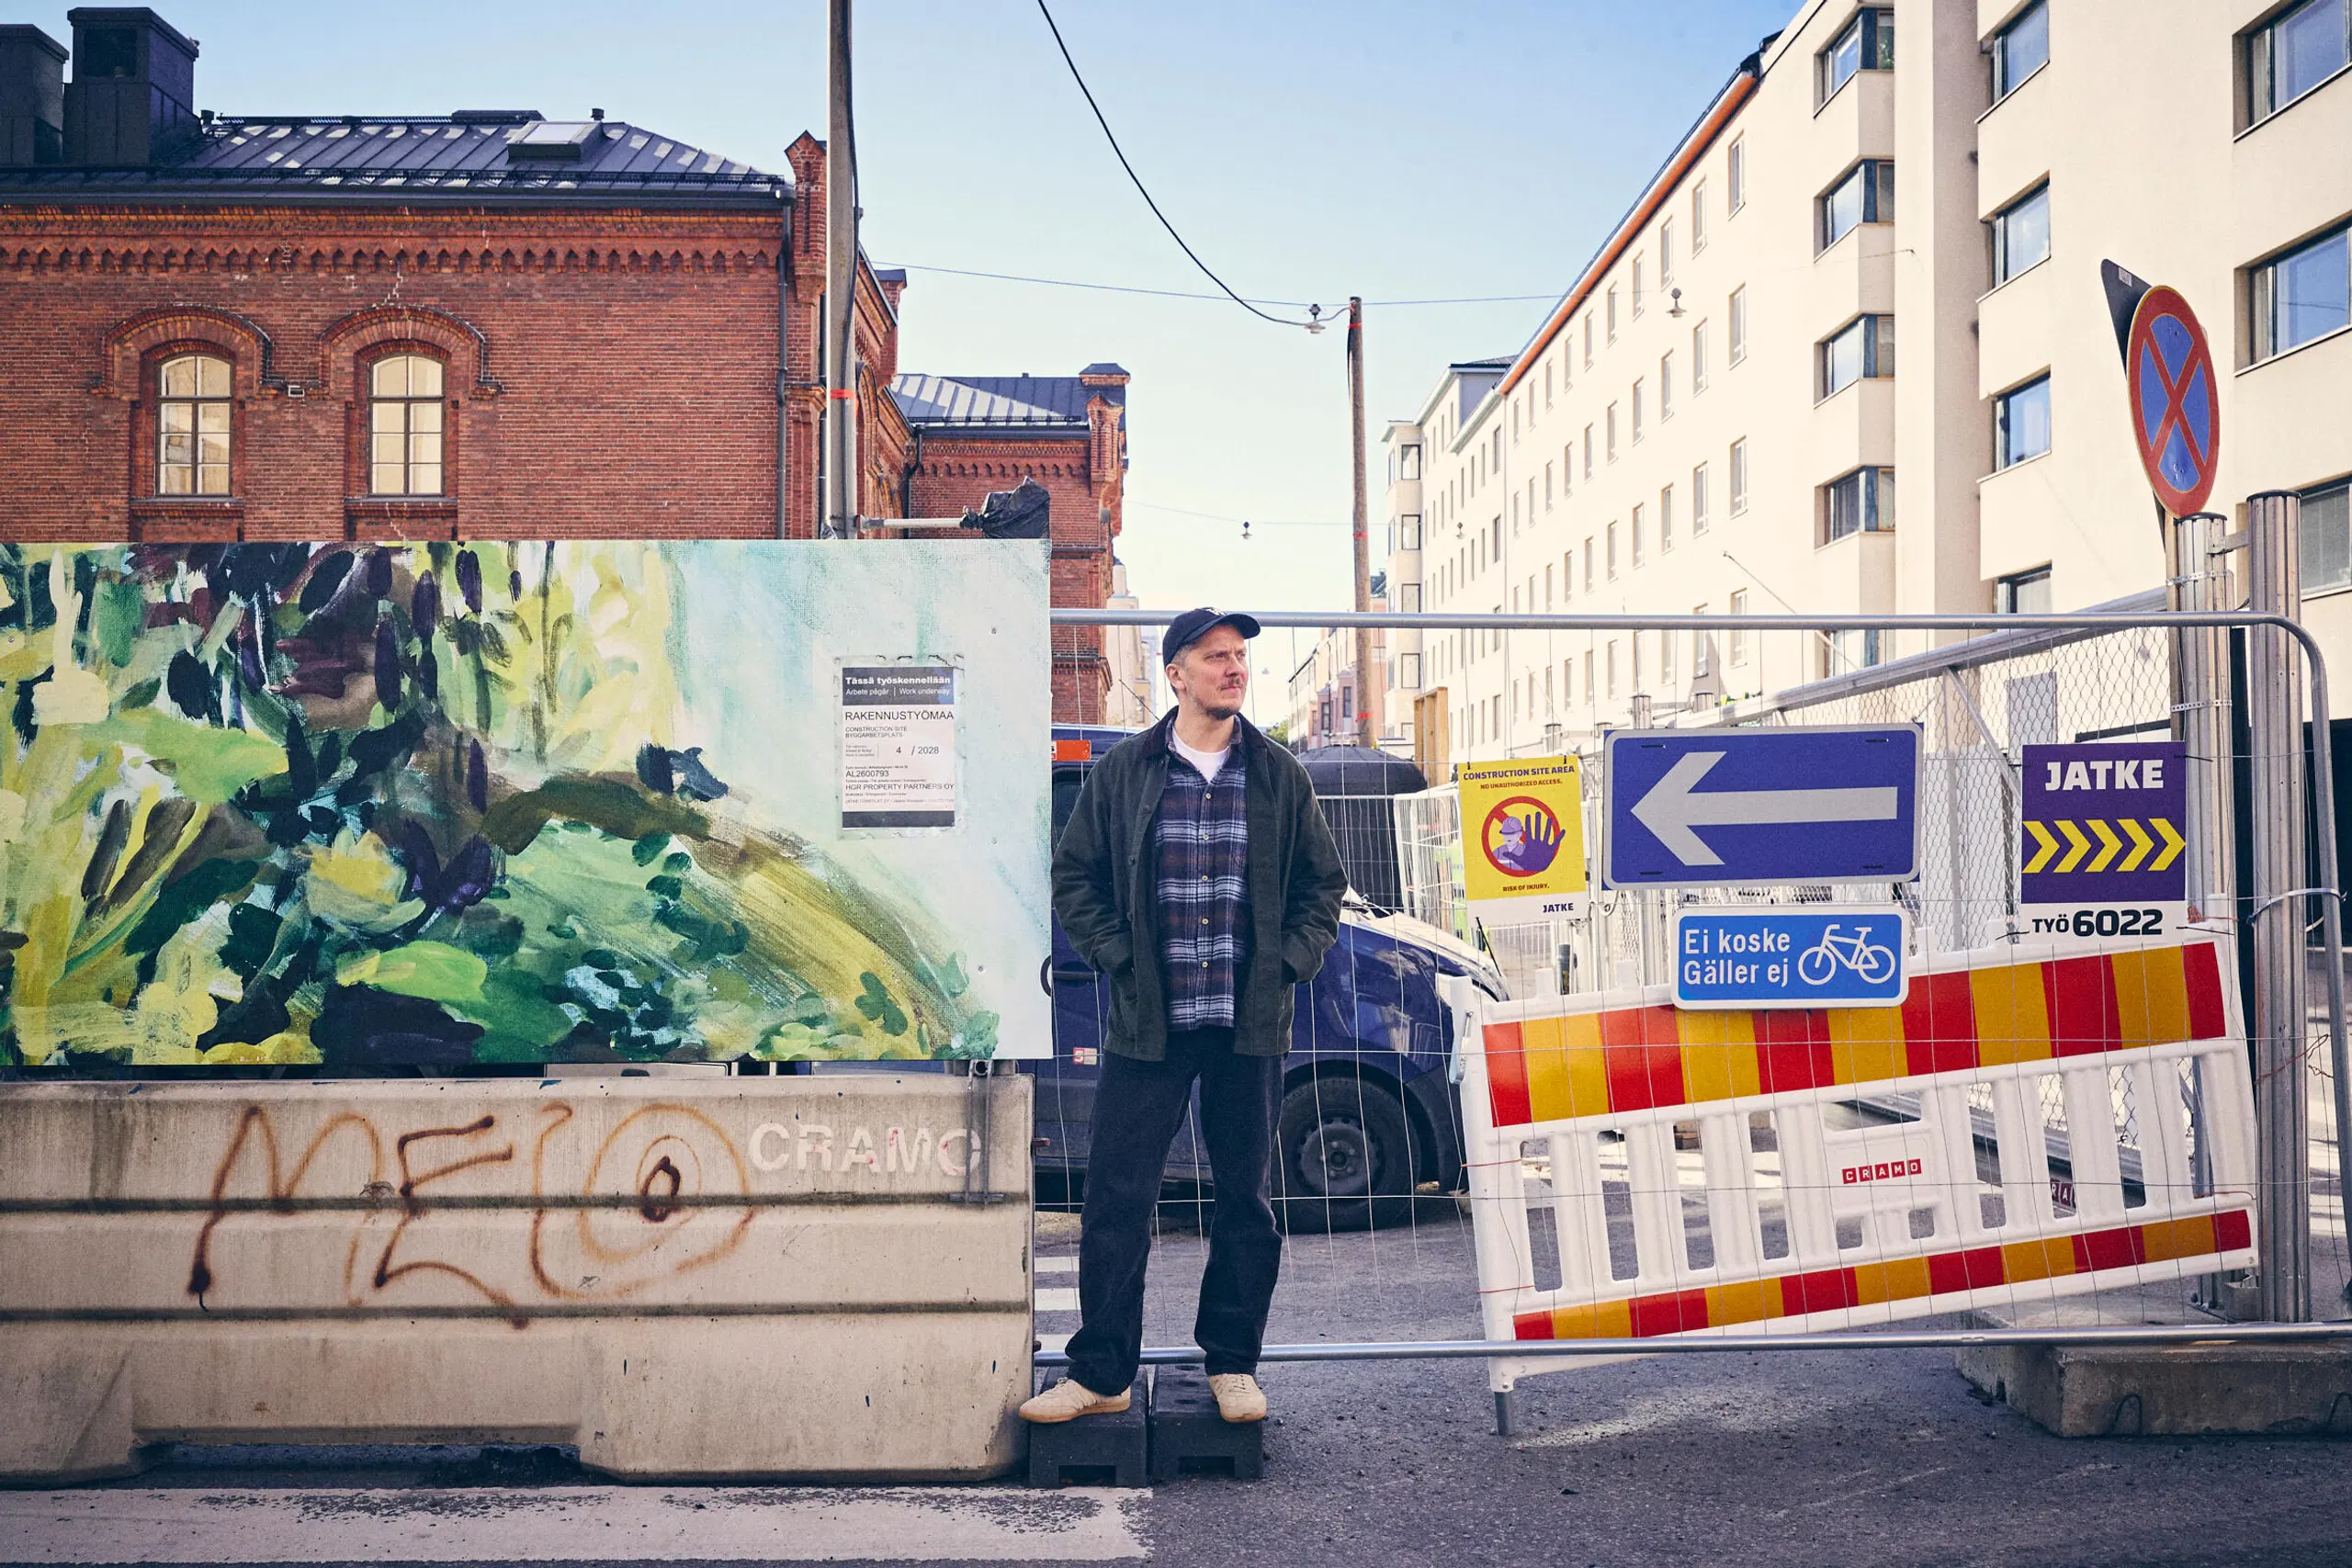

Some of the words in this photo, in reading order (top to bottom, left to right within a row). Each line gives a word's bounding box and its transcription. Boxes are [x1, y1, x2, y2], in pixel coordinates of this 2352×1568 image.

[845, 677, 875, 685] Tässä
[876, 675, 951, 686] työskennellään
[869, 688, 889, 696] pågår
[918, 687, 950, 696] underway
[844, 709, 955, 721] RAKENNUSTYÖMAA
[896, 746, 901, 754] 4
[918, 746, 940, 755] 2028
[845, 770, 889, 778] AL2600793
[1463, 769, 1530, 781] CONSTRUCTION
[1531, 767, 1550, 775] SITE
[1551, 765, 1575, 774] AREA
[2045, 759, 2165, 791] JATKE
[1490, 781, 1538, 789] UNAUTHORIZED
[1543, 902, 1574, 914] JATKE
[2031, 914, 2069, 933] TYÖ
[2073, 908, 2164, 937] 6022
[1684, 929, 1709, 954] Ei
[1718, 927, 1791, 953] koske
[1683, 959, 1759, 986] Gäller
[1767, 960, 1789, 987] ej
[748, 1122, 981, 1177] CRAMO
[1845, 1161, 1919, 1181] CRAMO
